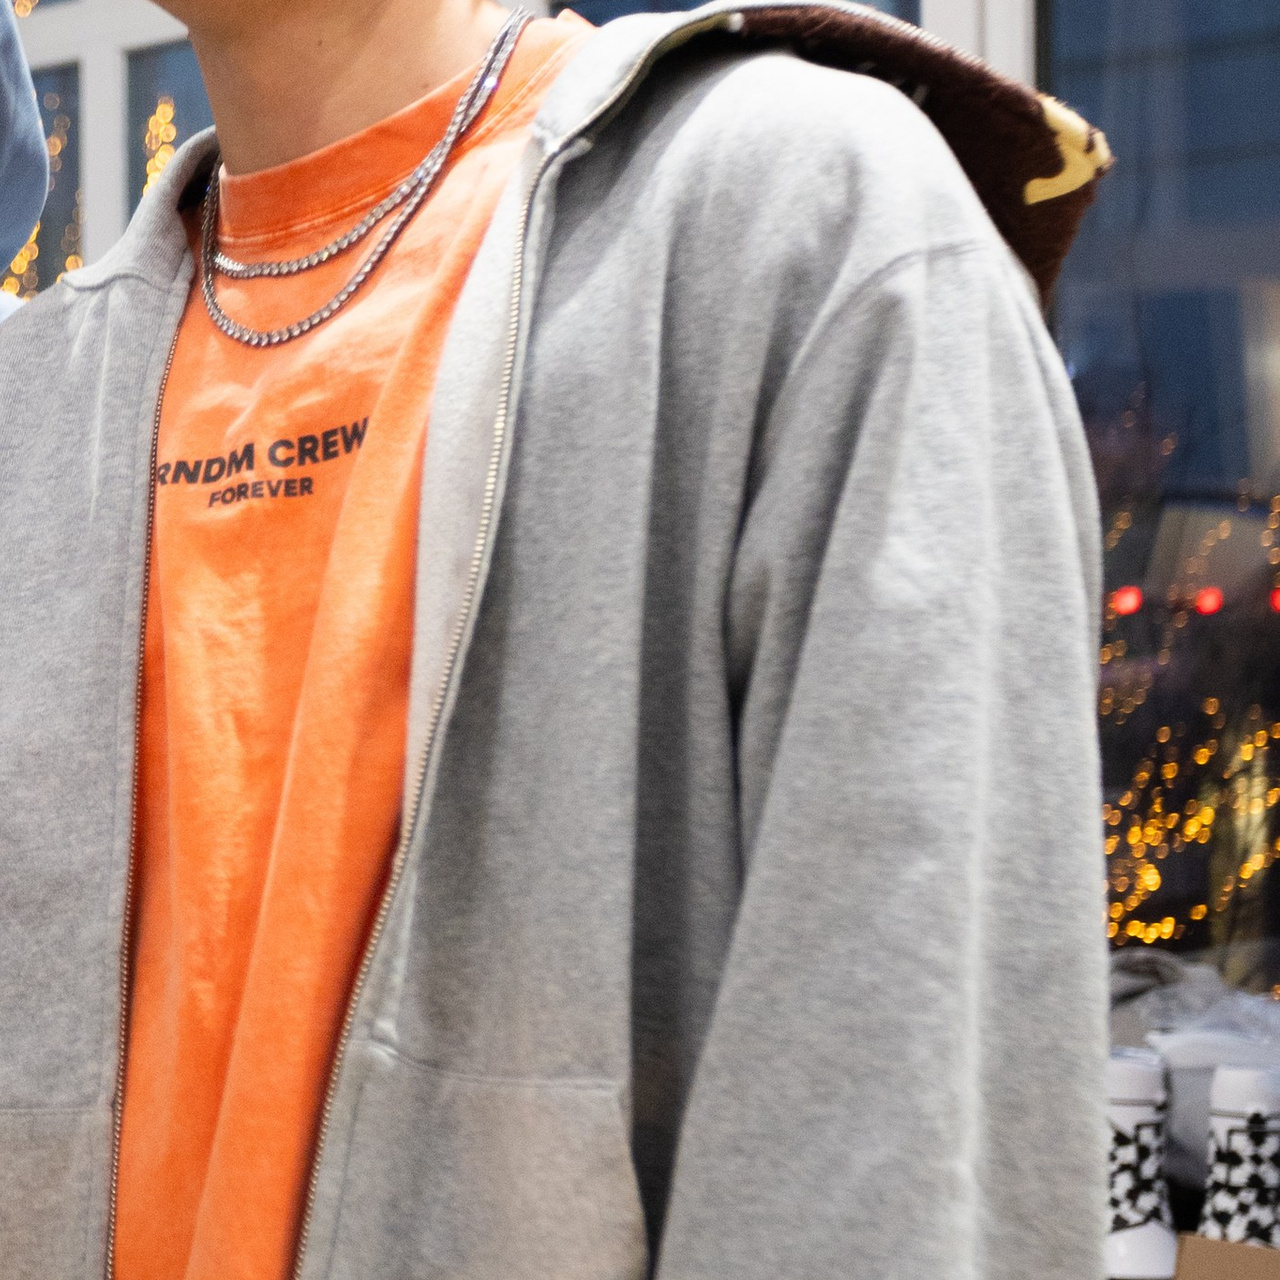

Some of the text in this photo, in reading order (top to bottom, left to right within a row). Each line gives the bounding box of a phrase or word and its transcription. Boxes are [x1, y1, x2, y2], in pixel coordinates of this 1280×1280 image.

[157, 416, 370, 486] RNDM CREW
[208, 476, 314, 508] FOREVER
